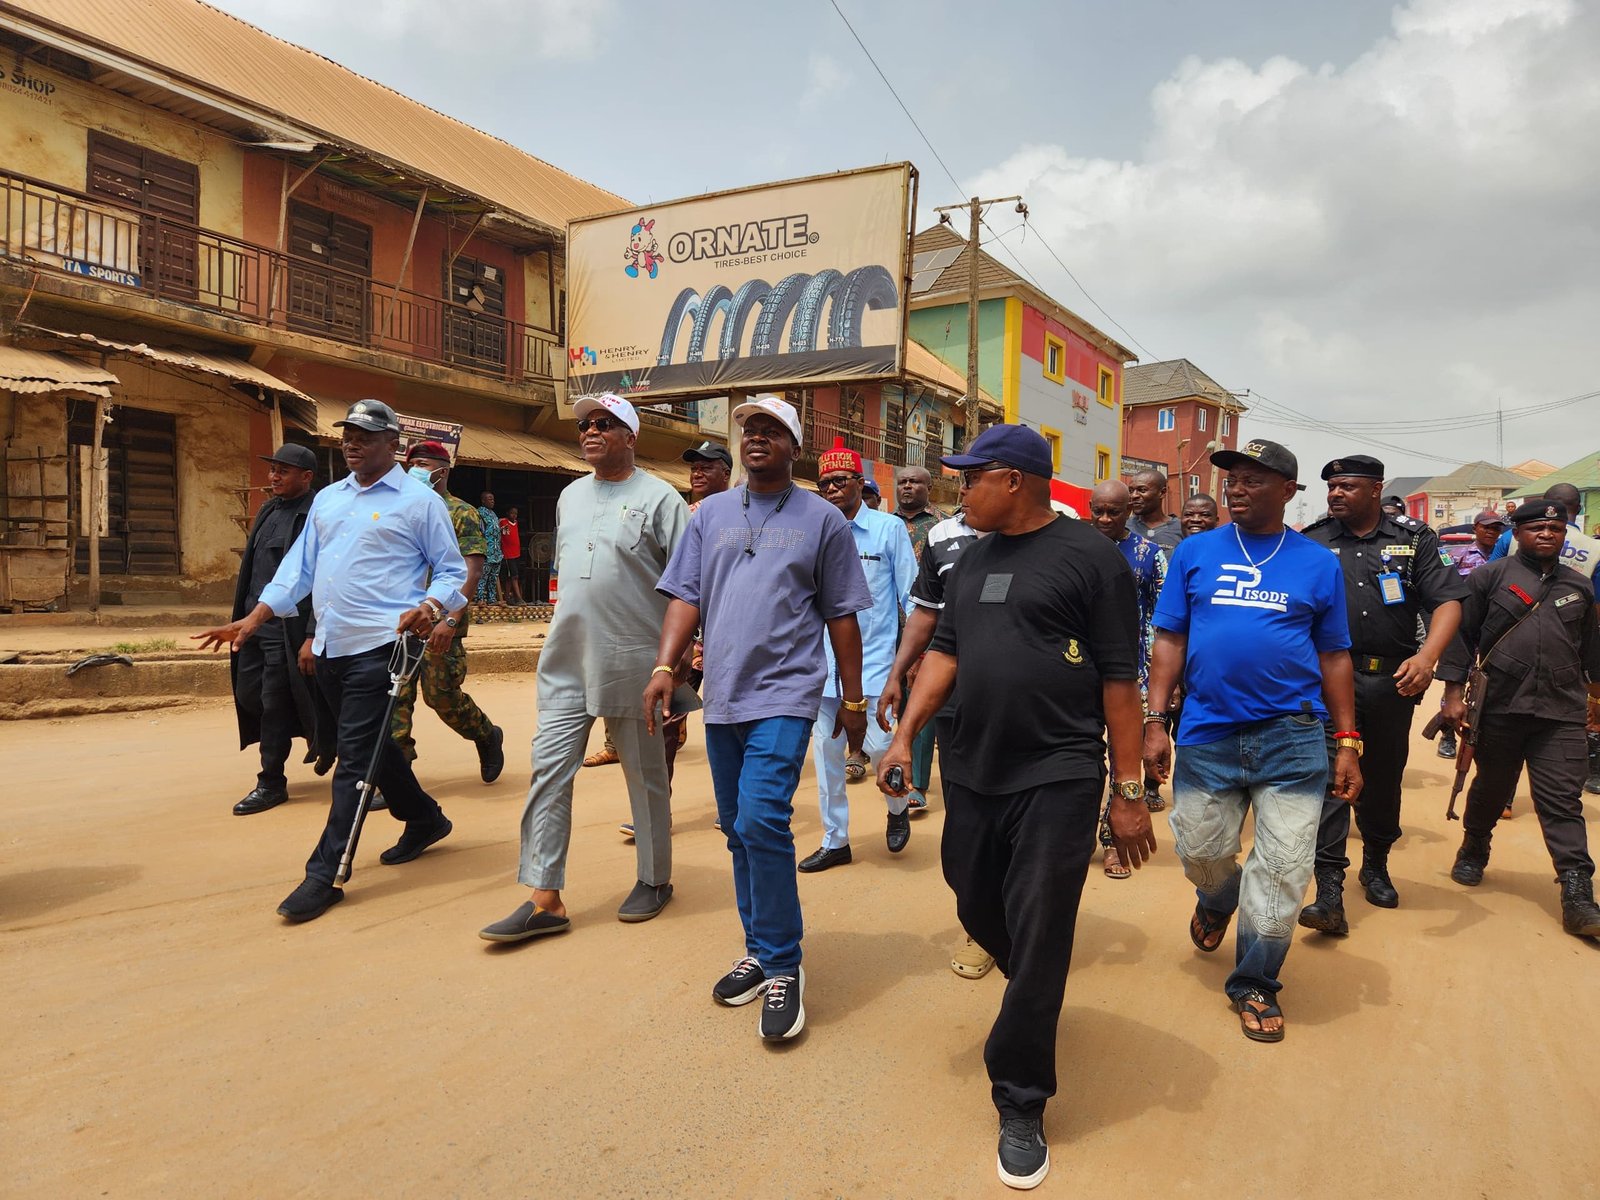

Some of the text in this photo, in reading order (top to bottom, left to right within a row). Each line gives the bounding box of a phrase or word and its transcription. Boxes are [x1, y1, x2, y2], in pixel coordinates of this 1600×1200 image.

[11, 72, 56, 96] SHOP
[668, 214, 808, 263] ORNATE
[714, 249, 807, 269] TIRES-BEST CHOICE
[89, 265, 135, 286] SPORTS
[600, 345, 637, 355] HENRY
[1560, 541, 1589, 562] bs
